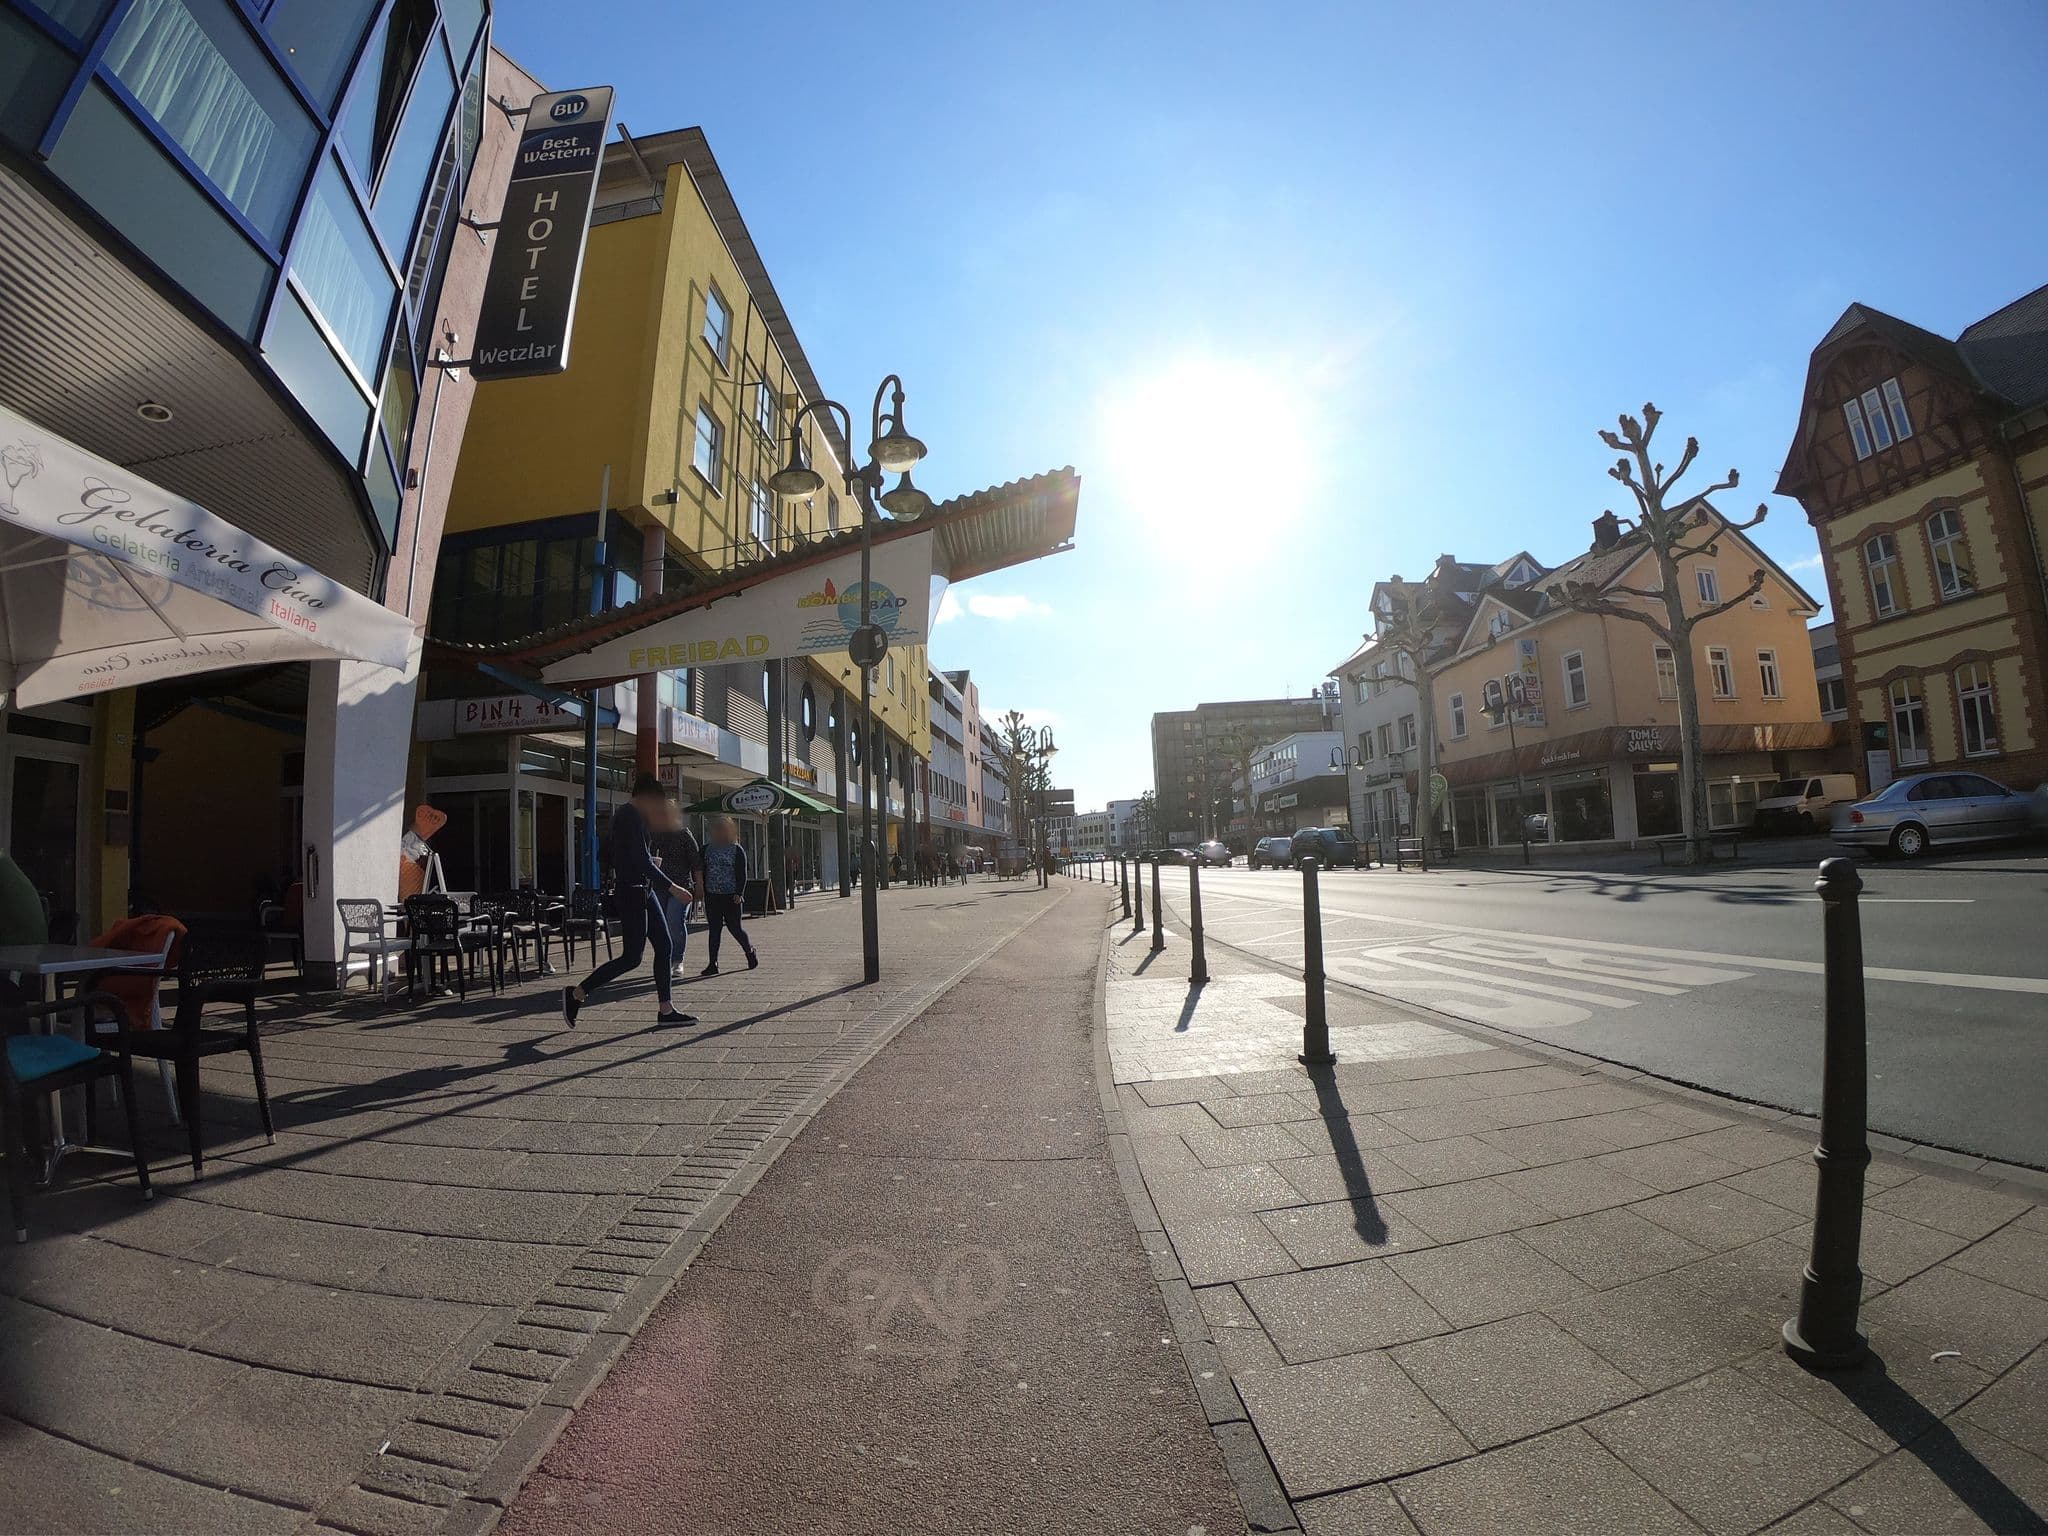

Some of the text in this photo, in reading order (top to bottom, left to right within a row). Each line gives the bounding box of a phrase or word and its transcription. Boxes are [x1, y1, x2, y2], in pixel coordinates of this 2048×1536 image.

[554, 102, 585, 116] BW
[542, 136, 579, 150] Best
[524, 146, 592, 163] Western
[517, 190, 559, 331] HOTEL
[479, 343, 556, 364] Wetzlar
[57, 476, 252, 574] Gelateria
[260, 561, 325, 609] Ciao
[92, 525, 180, 572] Gelateria
[270, 599, 318, 633] Italiana
[870, 597, 908, 610] BAD
[629, 634, 770, 669] FREIBAD
[466, 699, 521, 721] BINH
[1628, 729, 1651, 741] TOM
[1628, 740, 1664, 752] SALLY'S
